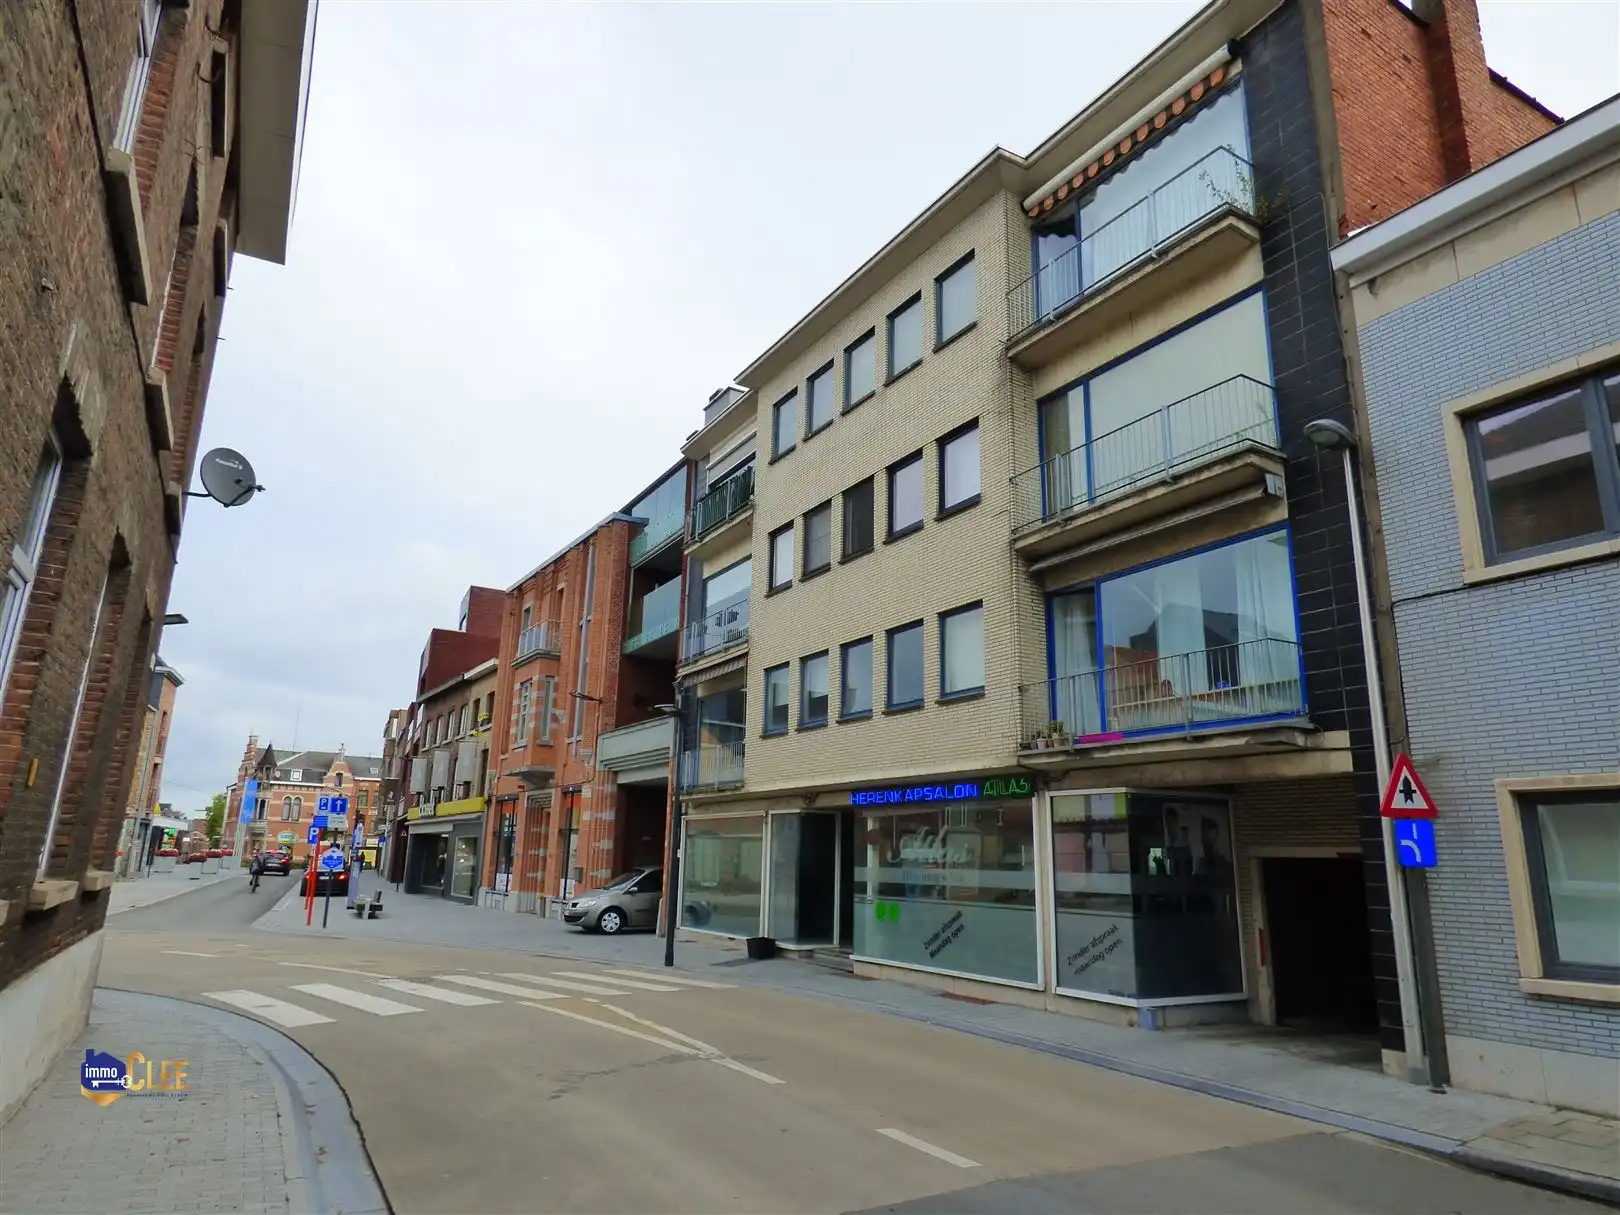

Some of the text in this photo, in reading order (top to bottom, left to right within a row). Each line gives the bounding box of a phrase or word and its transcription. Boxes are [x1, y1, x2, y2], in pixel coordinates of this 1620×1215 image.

[849, 777, 1030, 806] HERENKAPSALON ATLAS
[309, 827, 320, 841] P
[1066, 923, 1120, 967] Zonder afspraak
[1073, 938, 1124, 977] maandag open
